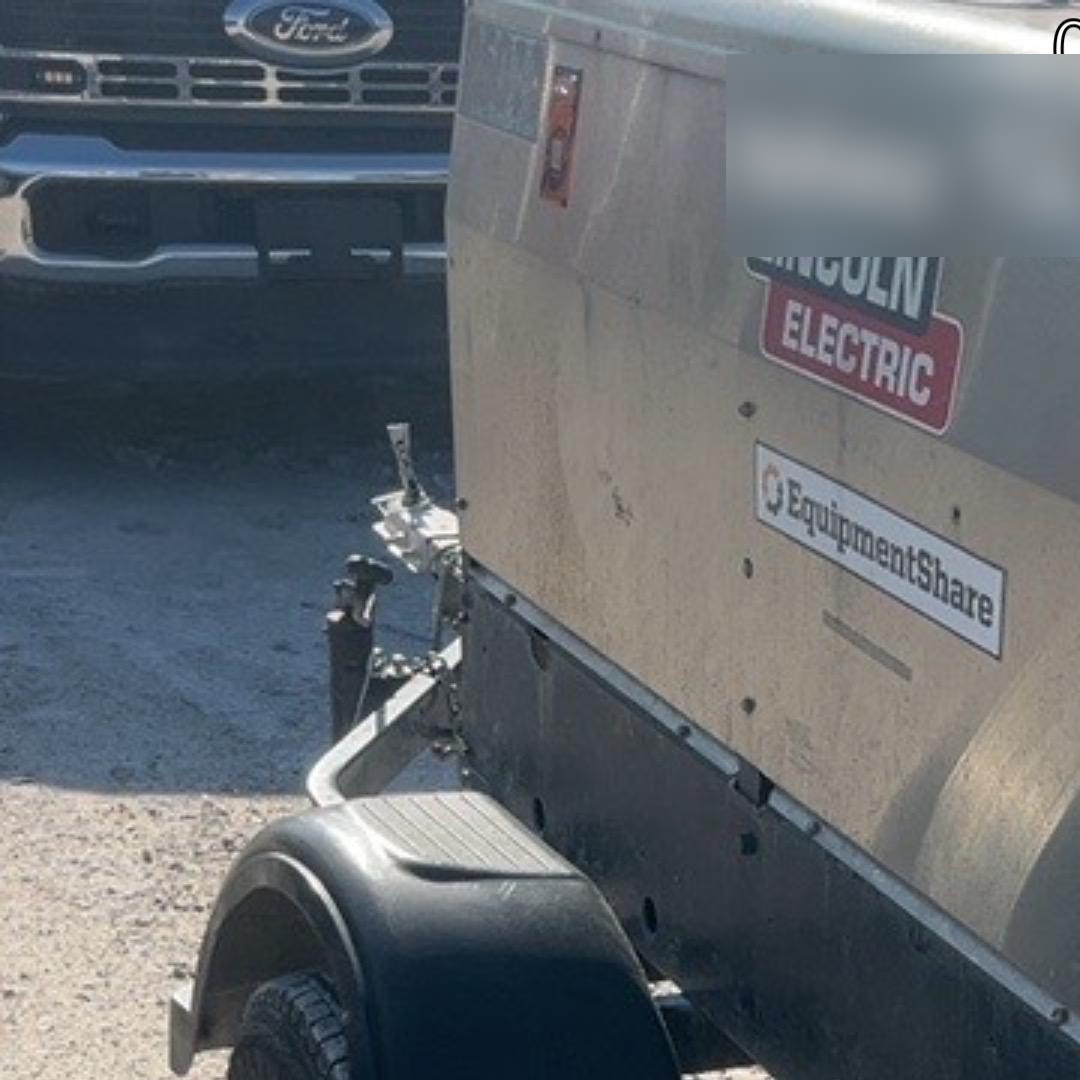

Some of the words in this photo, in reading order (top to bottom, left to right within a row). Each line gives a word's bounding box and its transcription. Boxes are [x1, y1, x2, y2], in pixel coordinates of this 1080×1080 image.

[274, 7, 349, 42] Ford
[781, 299, 934, 407] ELECTRIC
[787, 476, 994, 628] EquipmentShare
